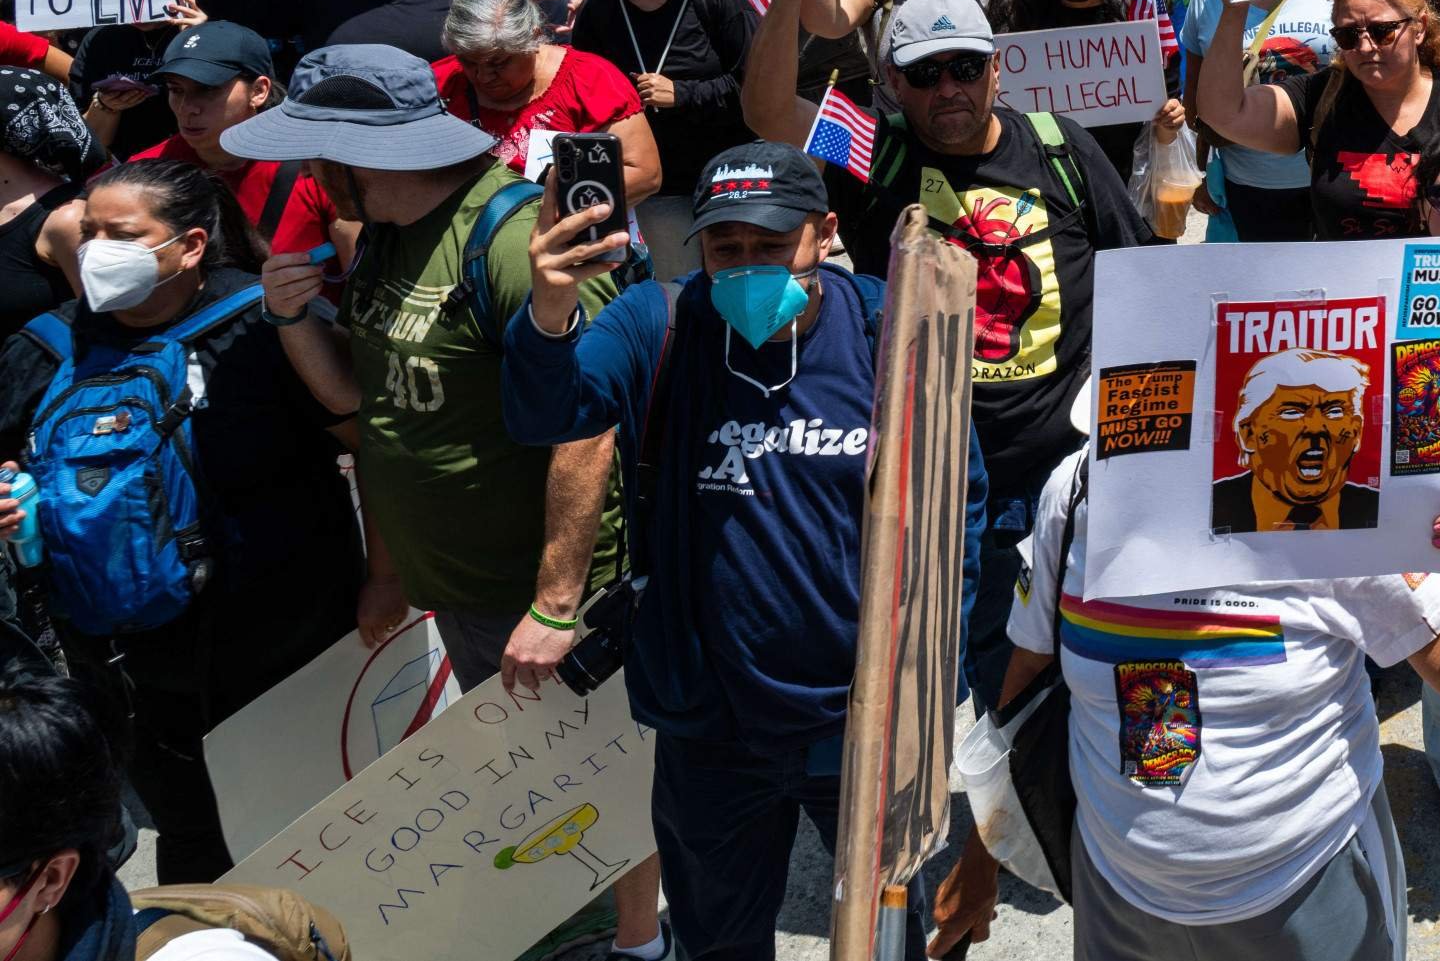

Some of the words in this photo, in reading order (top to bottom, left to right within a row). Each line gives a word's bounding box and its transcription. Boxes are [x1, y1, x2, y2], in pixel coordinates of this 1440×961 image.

[931, 23, 957, 32] adidas
[1279, 21, 1329, 36] ILLEGAL
[1025, 76, 1153, 114] ILLEGAL
[588, 151, 611, 165] LA
[1412, 297, 1438, 311] GO
[1224, 306, 1381, 354] TRAITOR
[1106, 375, 1133, 388] The
[1138, 371, 1184, 387] Trump
[1107, 382, 1180, 402] Fascist
[1106, 397, 1179, 418] Regime
[1100, 417, 1151, 436] MUST
[1155, 415, 1183, 430] GO
[1103, 430, 1172, 452] NOW!!!
[1173, 597, 1207, 607] PRIDE
[1210, 599, 1222, 607] IS
[1225, 599, 1260, 609] GOOD.
[1142, 748, 1197, 770] DEMOCRACY
[365, 789, 471, 873] GOOD
[474, 744, 536, 784] IN
[543, 698, 590, 750] MY
[377, 719, 654, 926] MARGARITA
